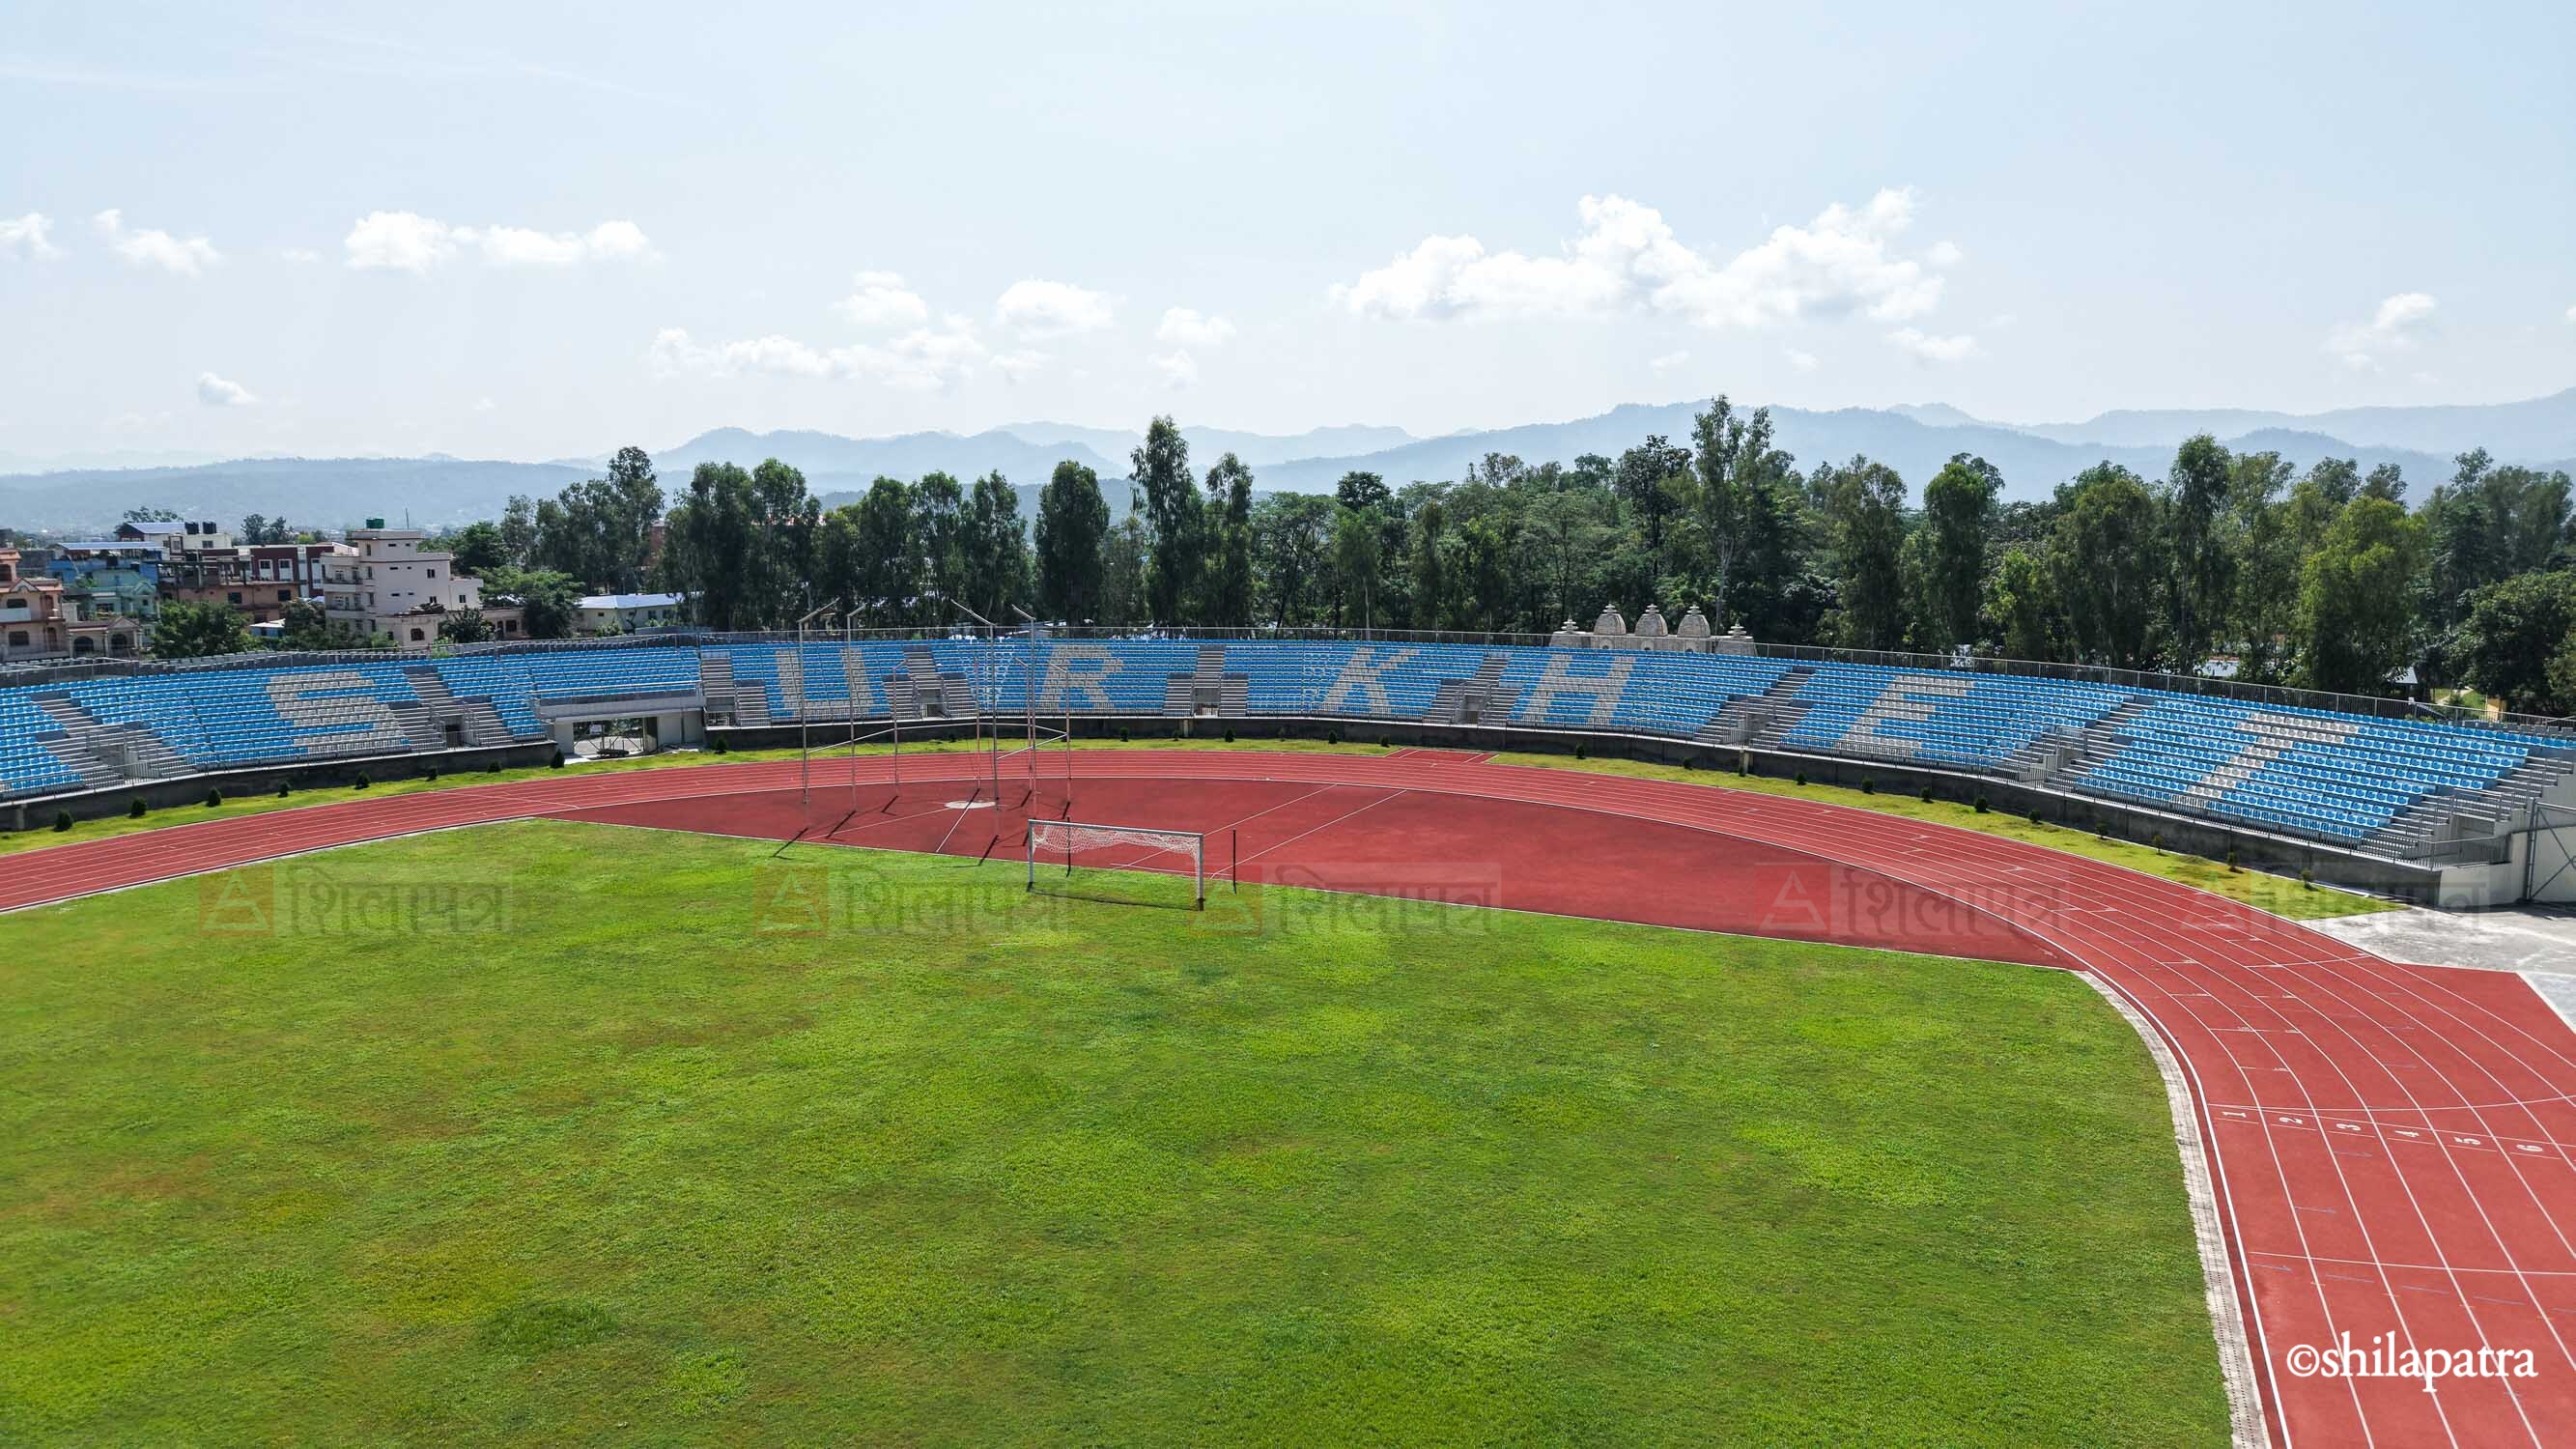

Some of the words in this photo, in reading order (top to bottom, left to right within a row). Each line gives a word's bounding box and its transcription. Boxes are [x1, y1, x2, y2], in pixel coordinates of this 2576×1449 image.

[2335, 1122, 2362, 1131] 3
[2394, 1129, 2420, 1138] 4
[2453, 1136, 2481, 1146] 5
[2516, 1144, 2543, 1152] 6
